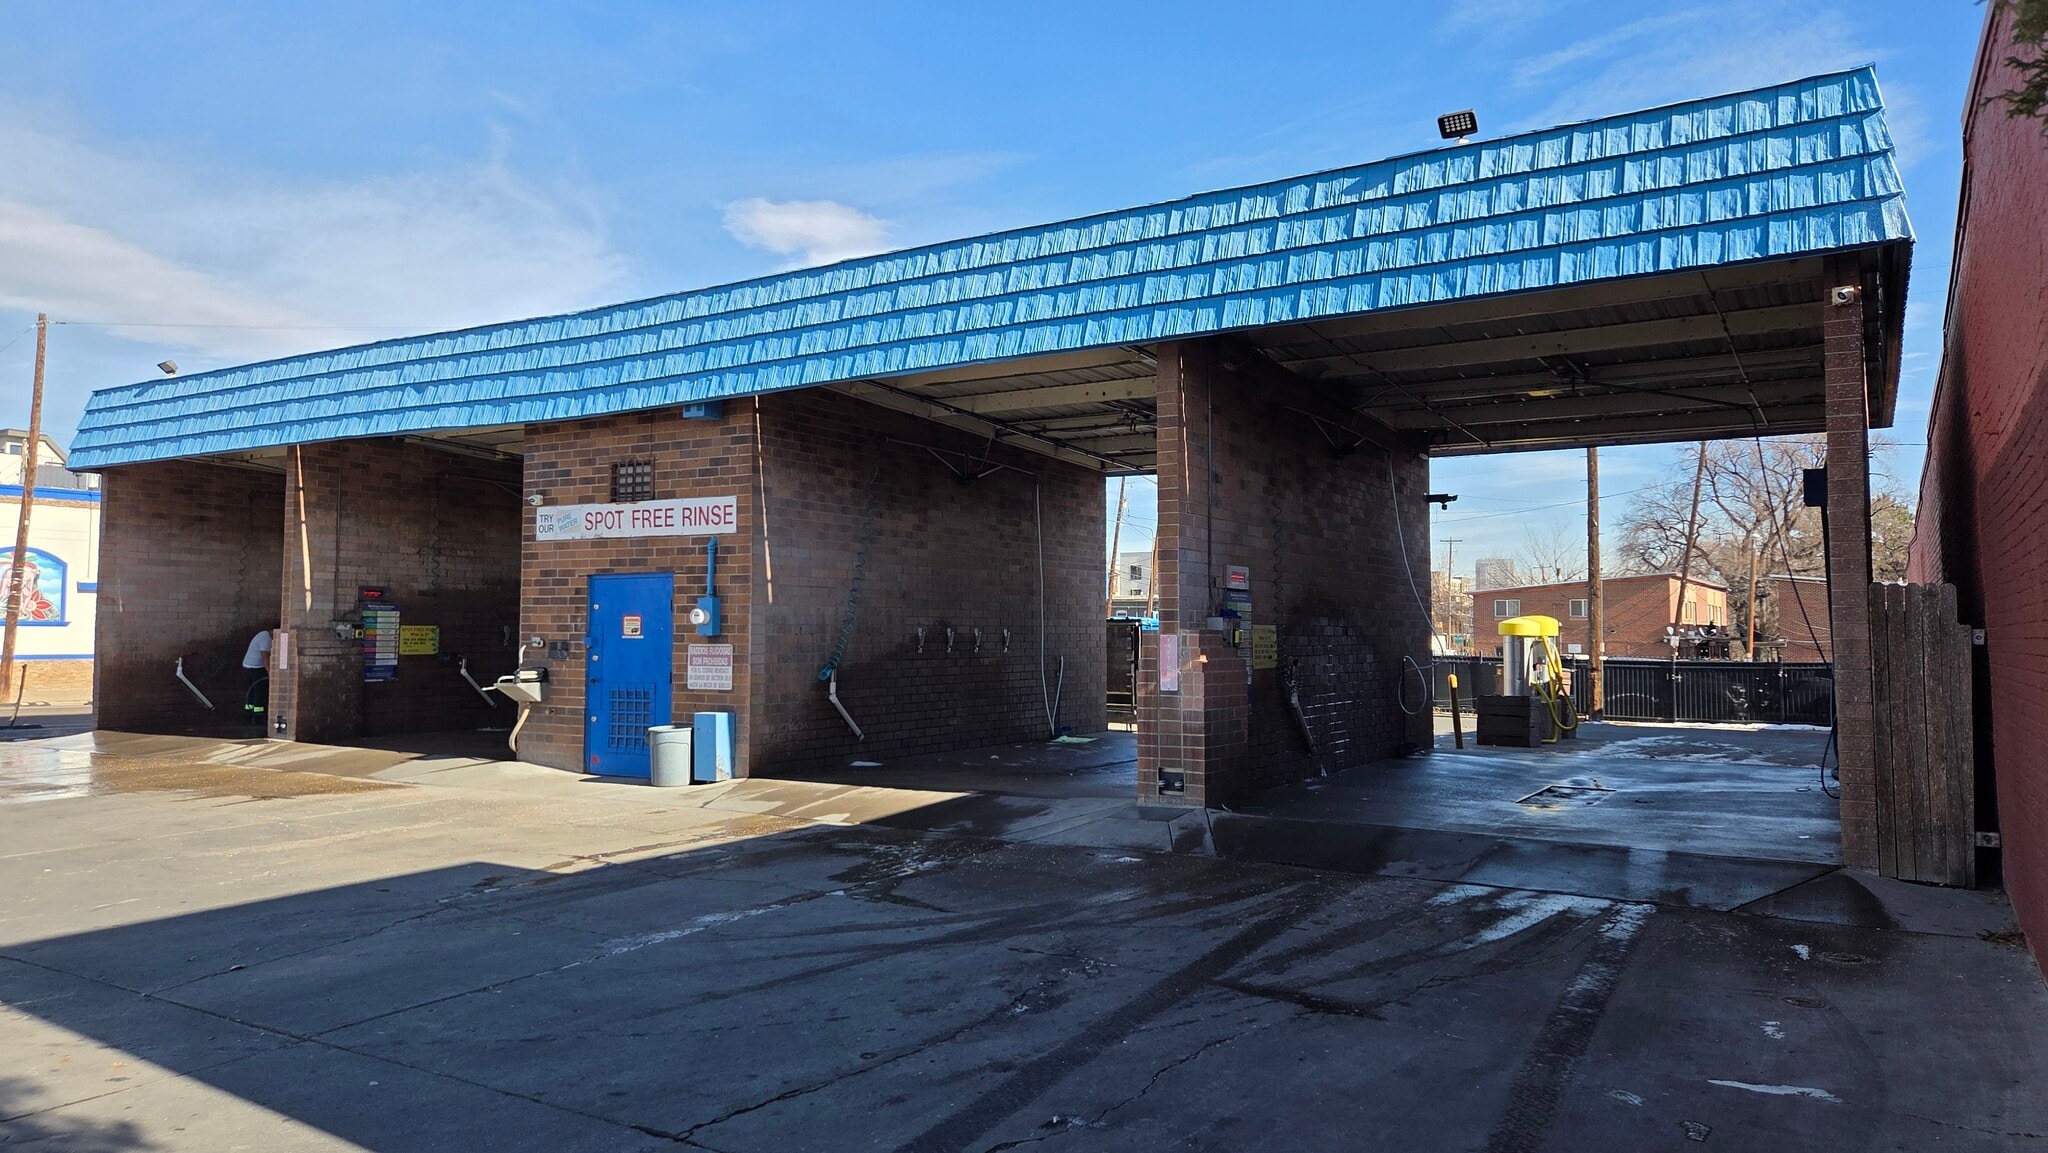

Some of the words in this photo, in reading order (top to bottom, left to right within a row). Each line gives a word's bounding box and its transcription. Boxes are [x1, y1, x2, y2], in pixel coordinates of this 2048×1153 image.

[539, 514, 554, 523] TRY
[557, 512, 573, 524] PURE
[584, 510, 624, 531] SPOT
[632, 507, 675, 529] FREE
[682, 504, 734, 527] RINSE
[538, 524, 554, 533] OUR
[559, 518, 579, 532] WATER
[692, 656, 703, 665] SON
